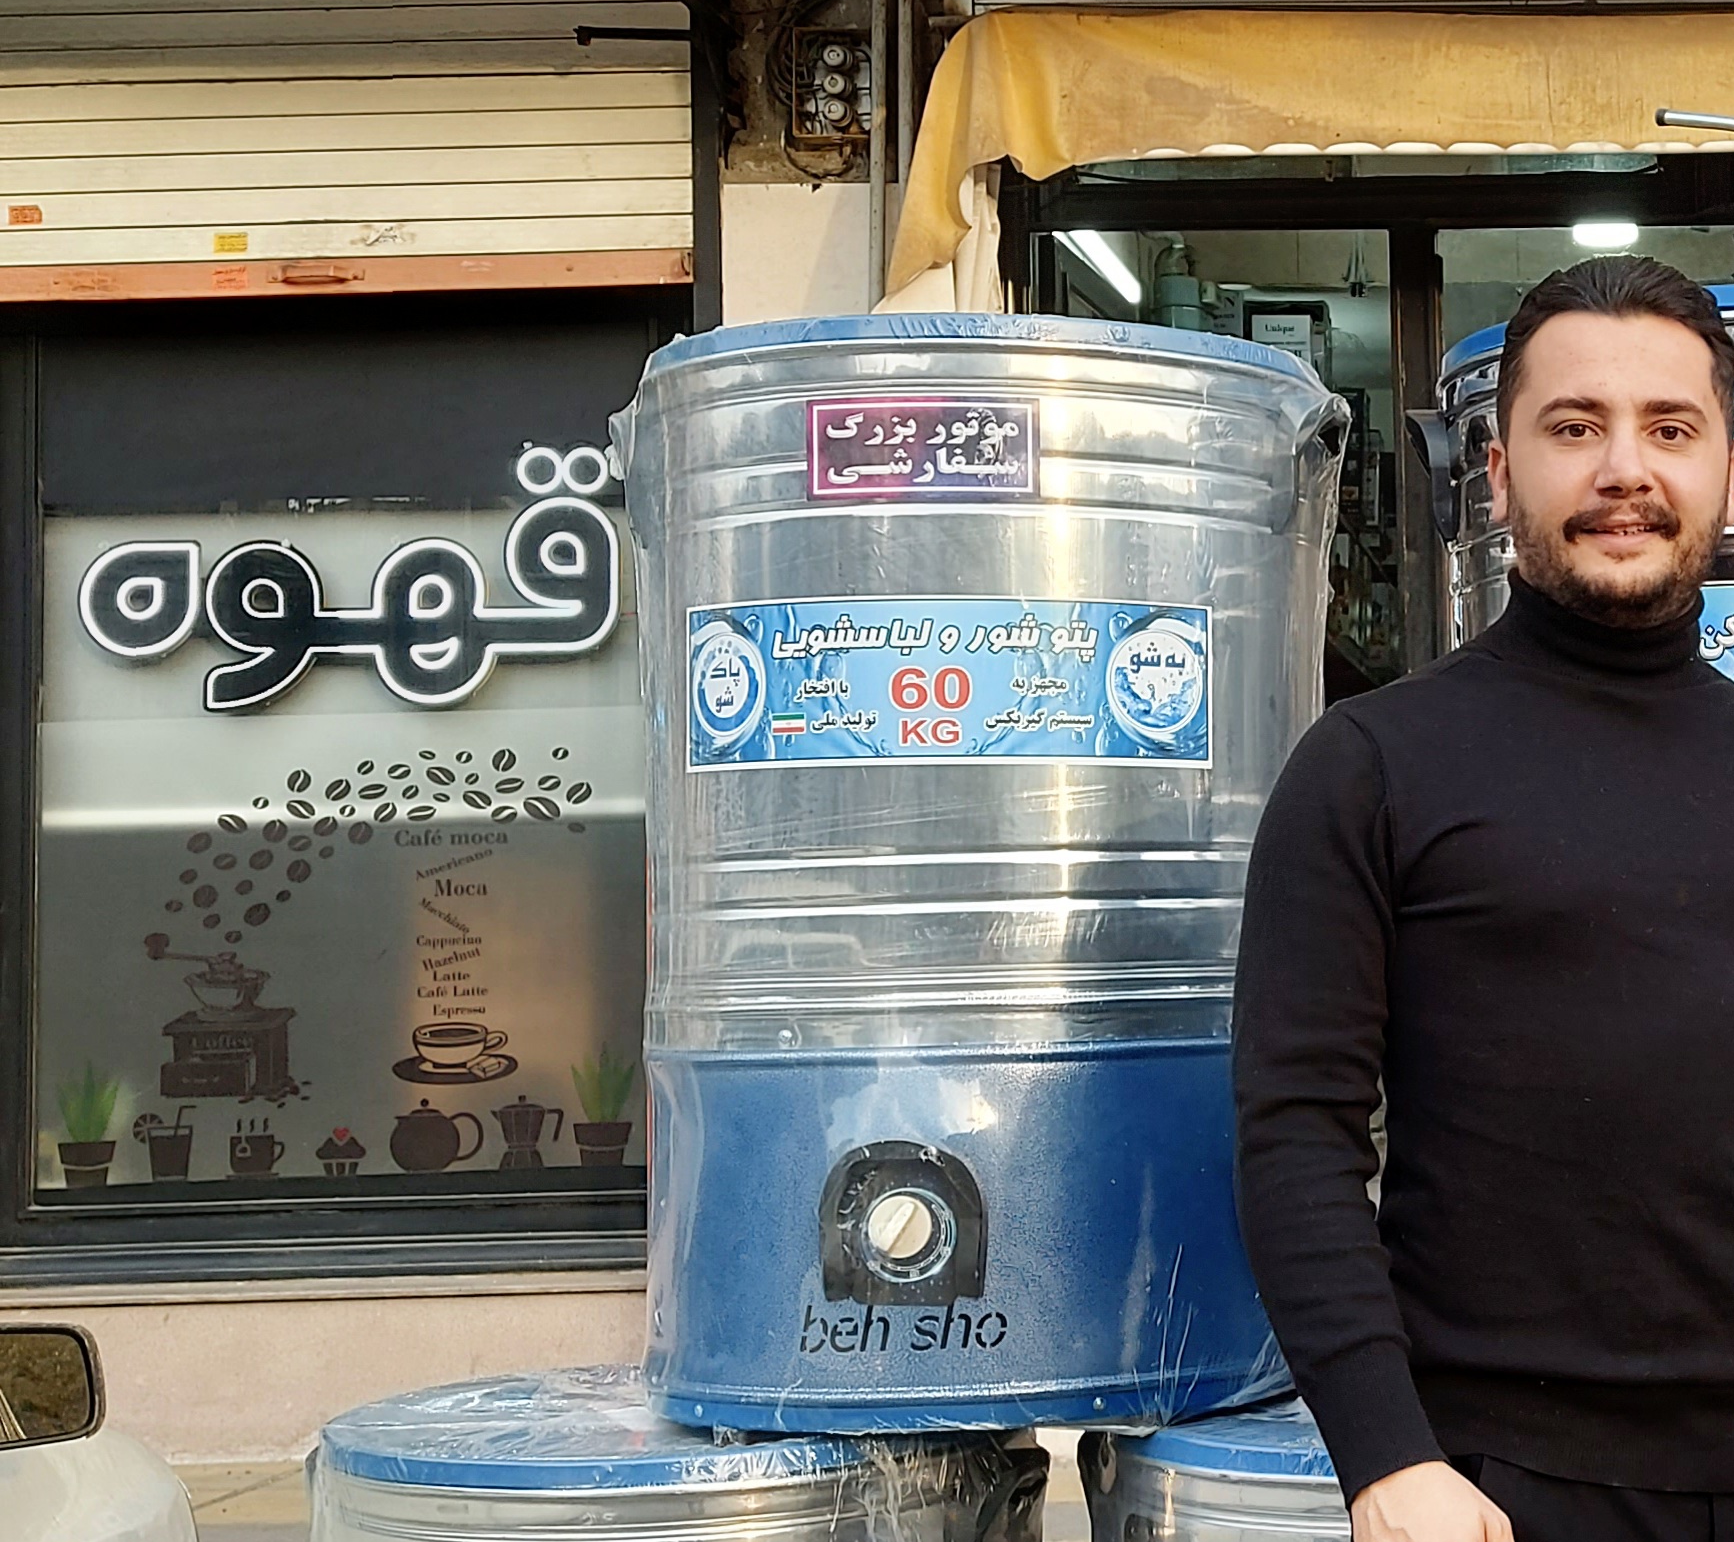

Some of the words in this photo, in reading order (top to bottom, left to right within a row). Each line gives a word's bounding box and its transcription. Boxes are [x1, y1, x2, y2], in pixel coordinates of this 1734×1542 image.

[824, 412, 917, 446] بزرگ
[78, 441, 620, 711] قهوه
[939, 625, 962, 656] و
[966, 612, 1038, 658] شور
[1035, 622, 1100, 664] پتو
[889, 666, 972, 711] 60
[898, 718, 962, 747] KG
[394, 829, 443, 847] Café
[450, 831, 509, 846] moca
[415, 848, 494, 882] Americano
[434, 878, 489, 897] Moca
[418, 897, 471, 935] Macchiato
[421, 947, 481, 972] Hazelnut
[416, 985, 448, 998] Café
[453, 985, 489, 997] Latte
[432, 970, 471, 982] Latte
[432, 1004, 487, 1019] Espresso
[800, 1305, 891, 1354] beh
[909, 1305, 1009, 1352] sho
